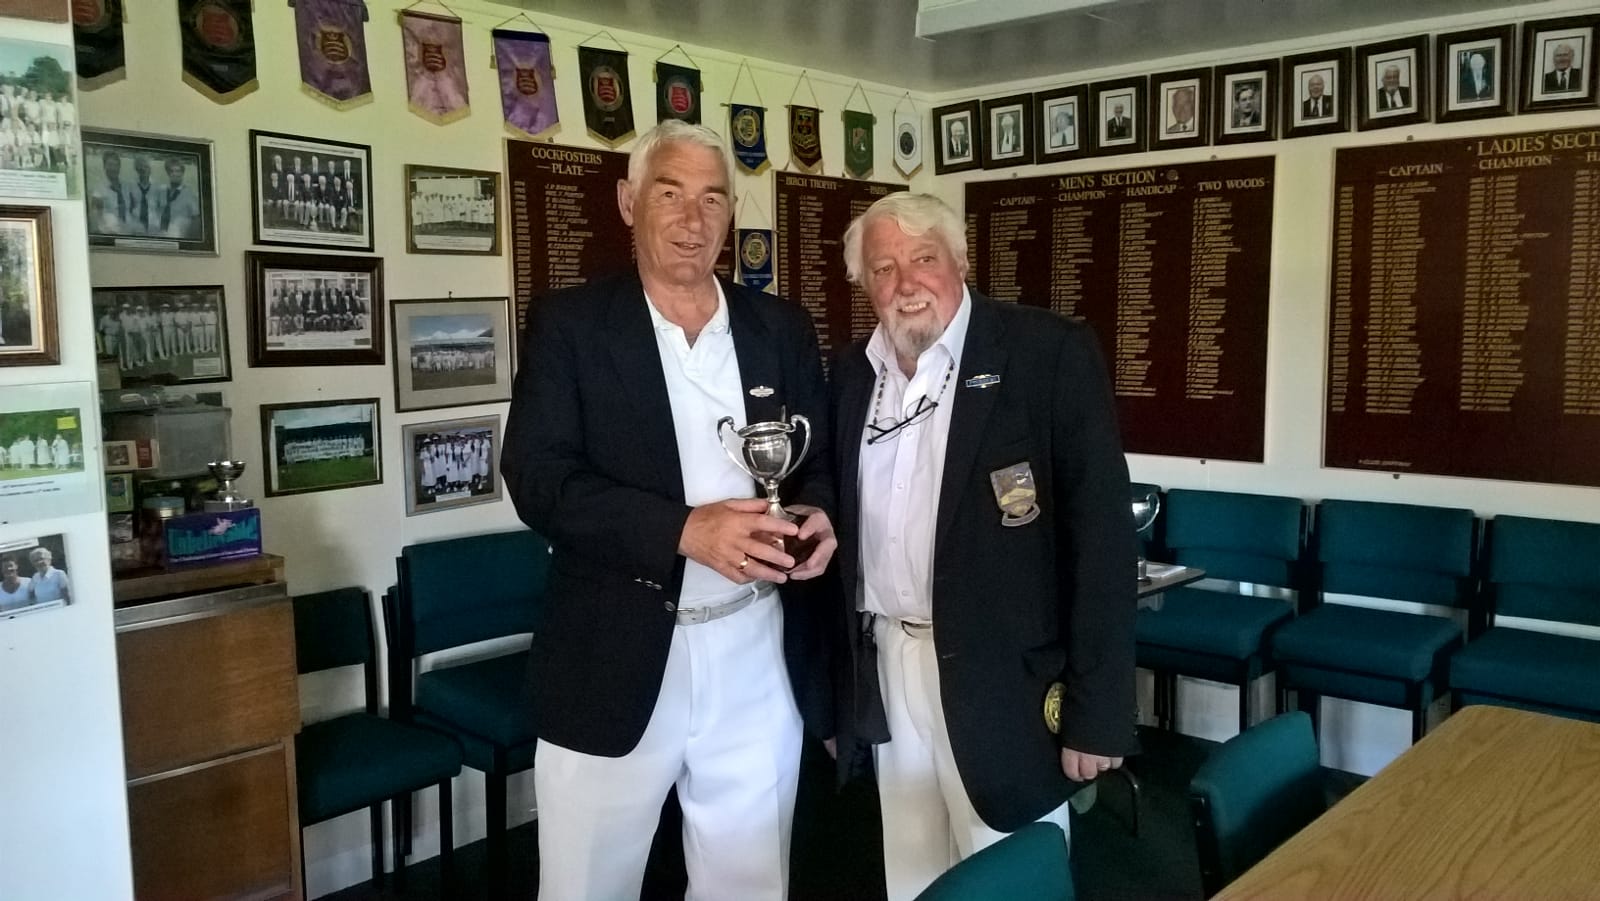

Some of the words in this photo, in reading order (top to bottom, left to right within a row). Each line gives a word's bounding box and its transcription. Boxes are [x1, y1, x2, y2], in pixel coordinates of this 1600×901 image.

[531, 147, 602, 164] COCKFOSTERS
[1479, 154, 1552, 170] CHAMPION
[552, 163, 584, 176] PLATE
[1389, 163, 1443, 177] CAPTAIN
[1059, 174, 1095, 190] MEN'S
[1101, 170, 1156, 187] SECTION
[1197, 181, 1222, 192] TWO
[1226, 177, 1265, 189] WOODS
[1058, 190, 1107, 202] CHAMPION
[1126, 184, 1177, 196] HANDICAP
[999, 195, 1036, 206] CAPTAIN
